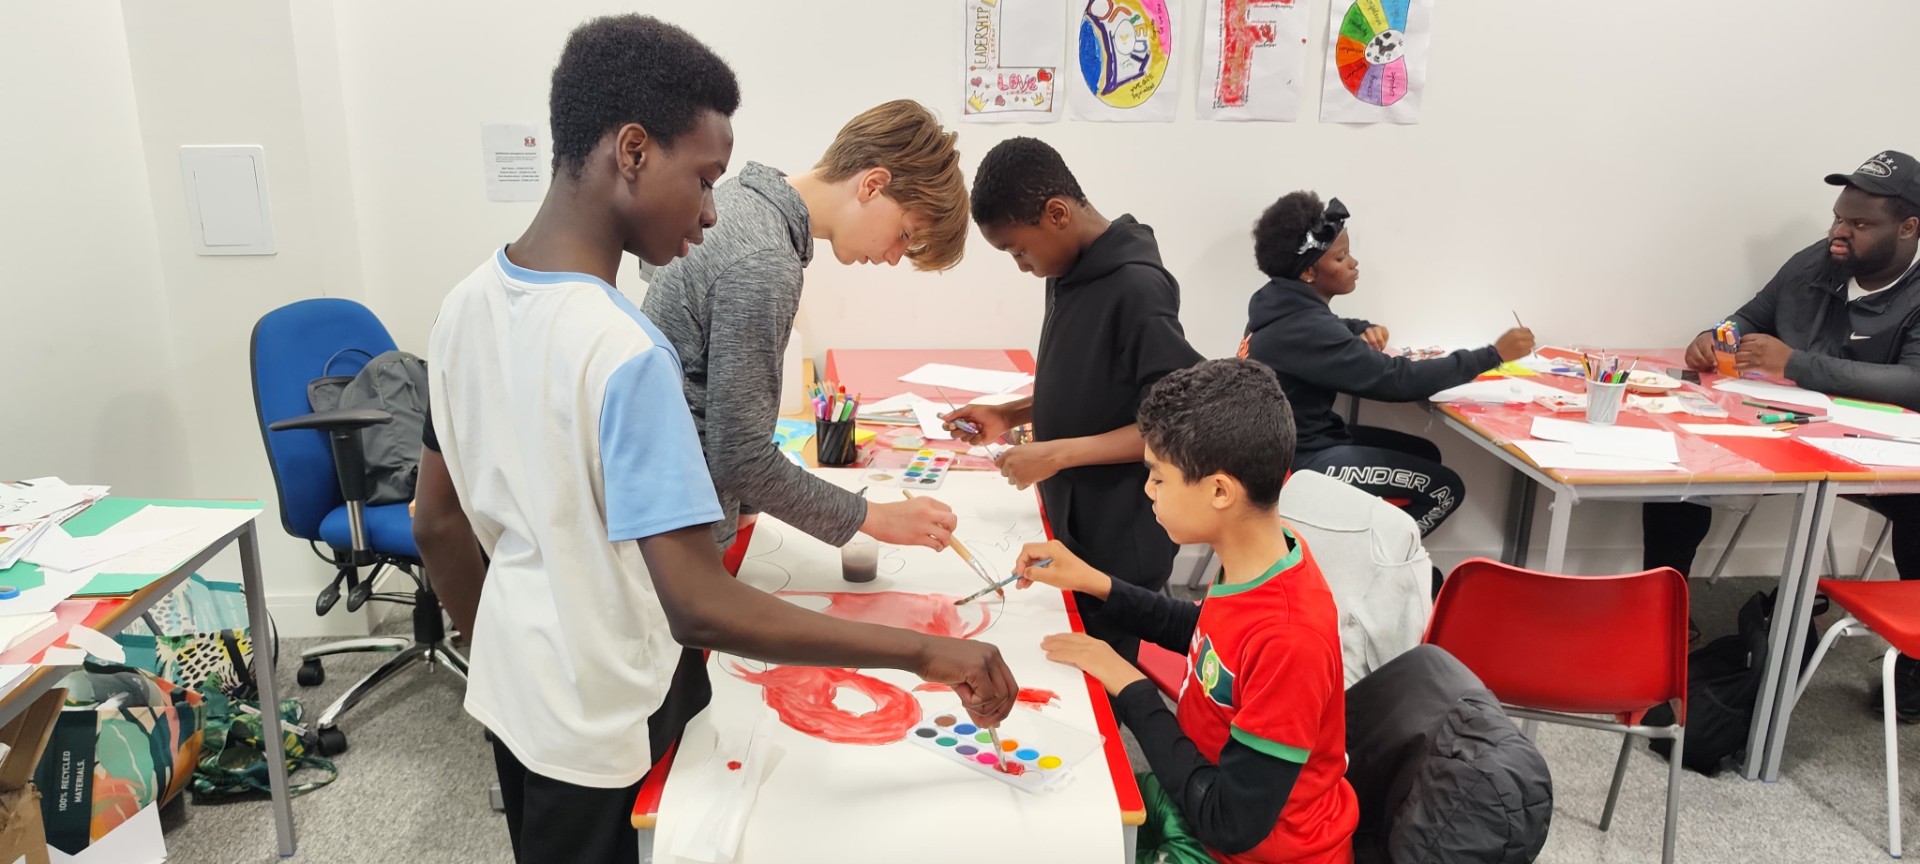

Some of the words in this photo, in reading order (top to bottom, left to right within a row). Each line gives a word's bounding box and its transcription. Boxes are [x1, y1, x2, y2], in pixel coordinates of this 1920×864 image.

[973, 6, 989, 70] LEADERSHIP
[1326, 466, 1430, 493] UNDER
[61, 750, 71, 790] RECYCLED
[74, 759, 85, 803] MATERIALS.
[59, 791, 68, 812] 100%
